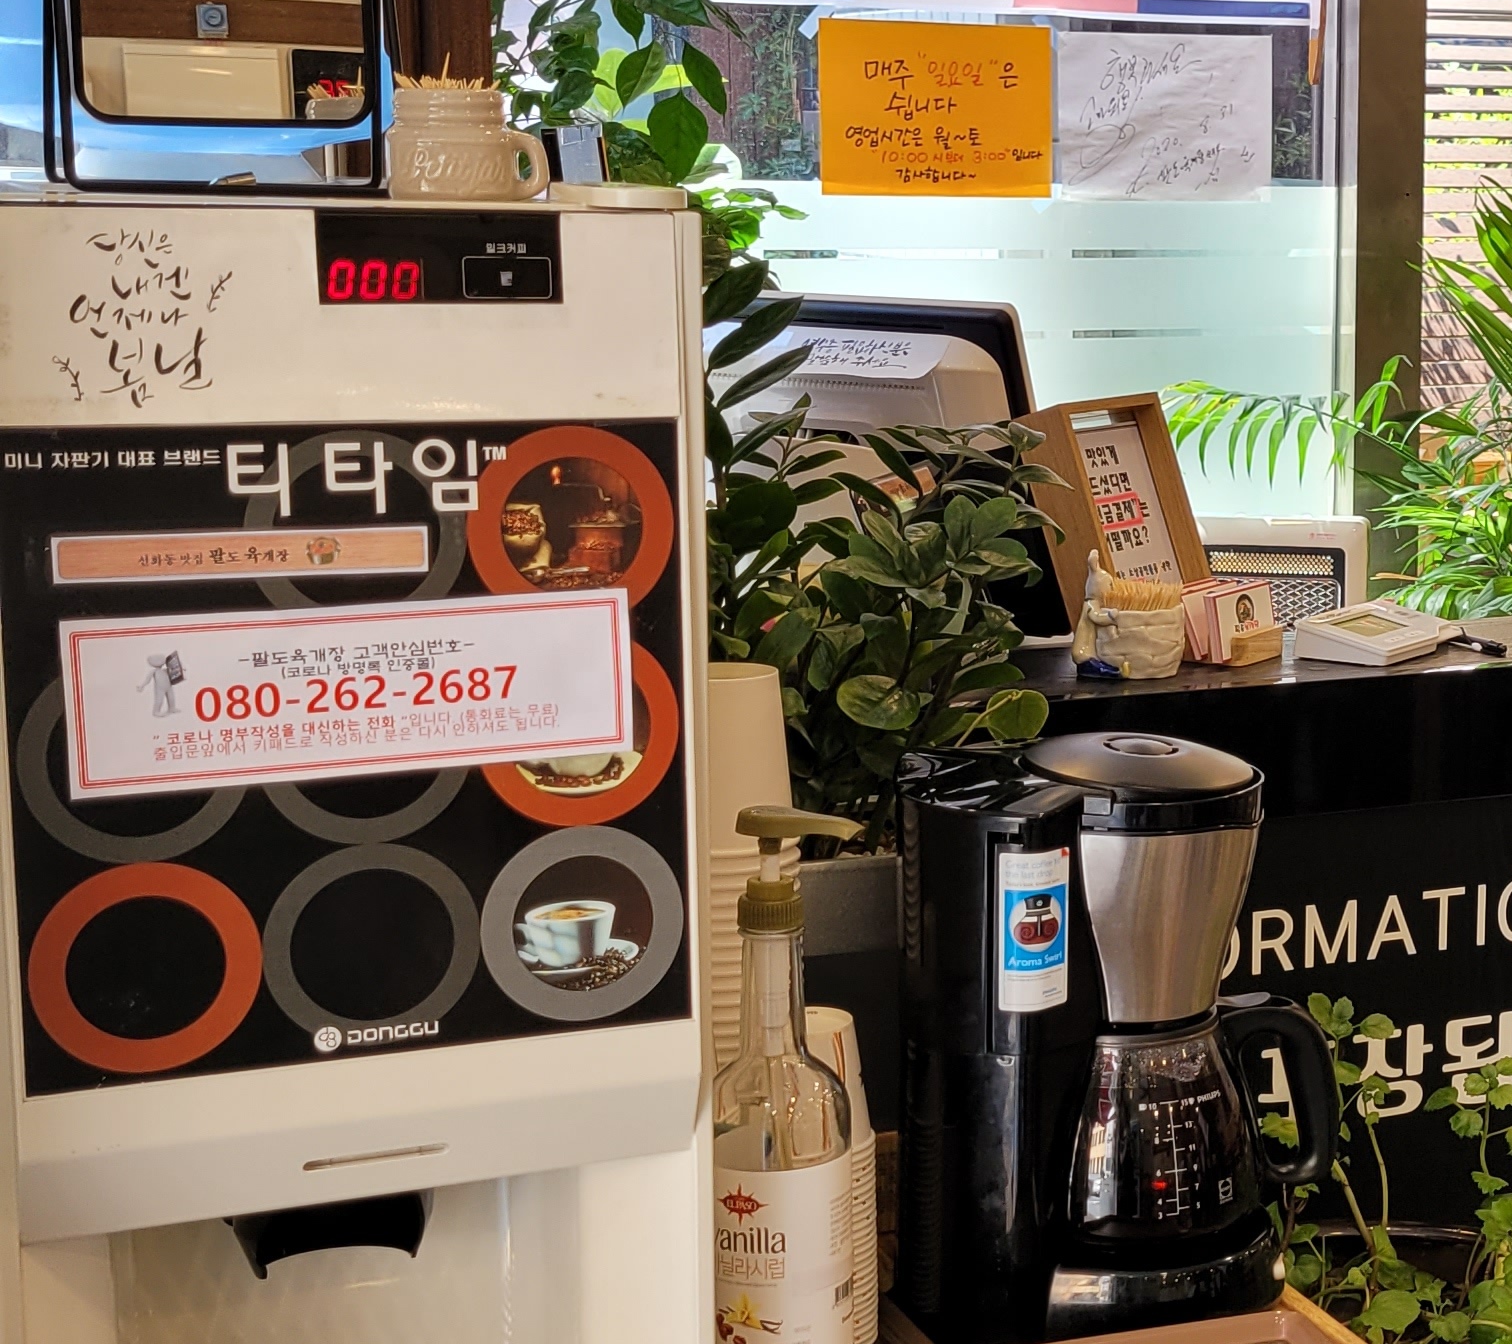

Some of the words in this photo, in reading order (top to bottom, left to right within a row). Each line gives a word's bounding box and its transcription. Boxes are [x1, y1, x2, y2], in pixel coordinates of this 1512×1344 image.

[864, 59, 914, 90] 매주
[884, 91, 957, 121] 쉽니다
[846, 125, 923, 148] 영업시간은
[933, 126, 983, 150] 월~토
[85, 228, 174, 269] 당신은
[485, 242, 528, 254] 밀크커피
[111, 266, 192, 301] 내겐
[327, 258, 420, 301] 000
[69, 294, 189, 339] 언제나
[100, 327, 213, 408] 봄날
[4, 452, 43, 470] 미니
[51, 449, 110, 469] 자판기
[117, 449, 157, 468] 대표
[163, 448, 222, 466] 브랜드
[1084, 444, 1120, 469] 맛있게
[1088, 471, 1133, 496] 드셨다면
[281, 664, 331, 680] (코로나
[337, 660, 381, 676] 방명록
[194, 665, 518, 723] 080-262-2687
[167, 729, 213, 745] 코로나
[219, 723, 296, 742] 명부작성을
[302, 718, 361, 736] 대신하는
[367, 715, 396, 730] 전화
[460, 705, 522, 725] (통화료는
[527, 703, 559, 717] 무료)
[154, 739, 247, 761] 출입문앞에서
[253, 736, 313, 752] 키패드로
[320, 729, 377, 747] 작성하신
[385, 728, 412, 742] 분은
[418, 725, 447, 739] 다시
[453, 719, 509, 737] 안하셔도
[1007, 955, 1042, 967] Aroma
[347, 1020, 439, 1046] DONGGU
[717, 1256, 785, 1280] 닐라시럽
